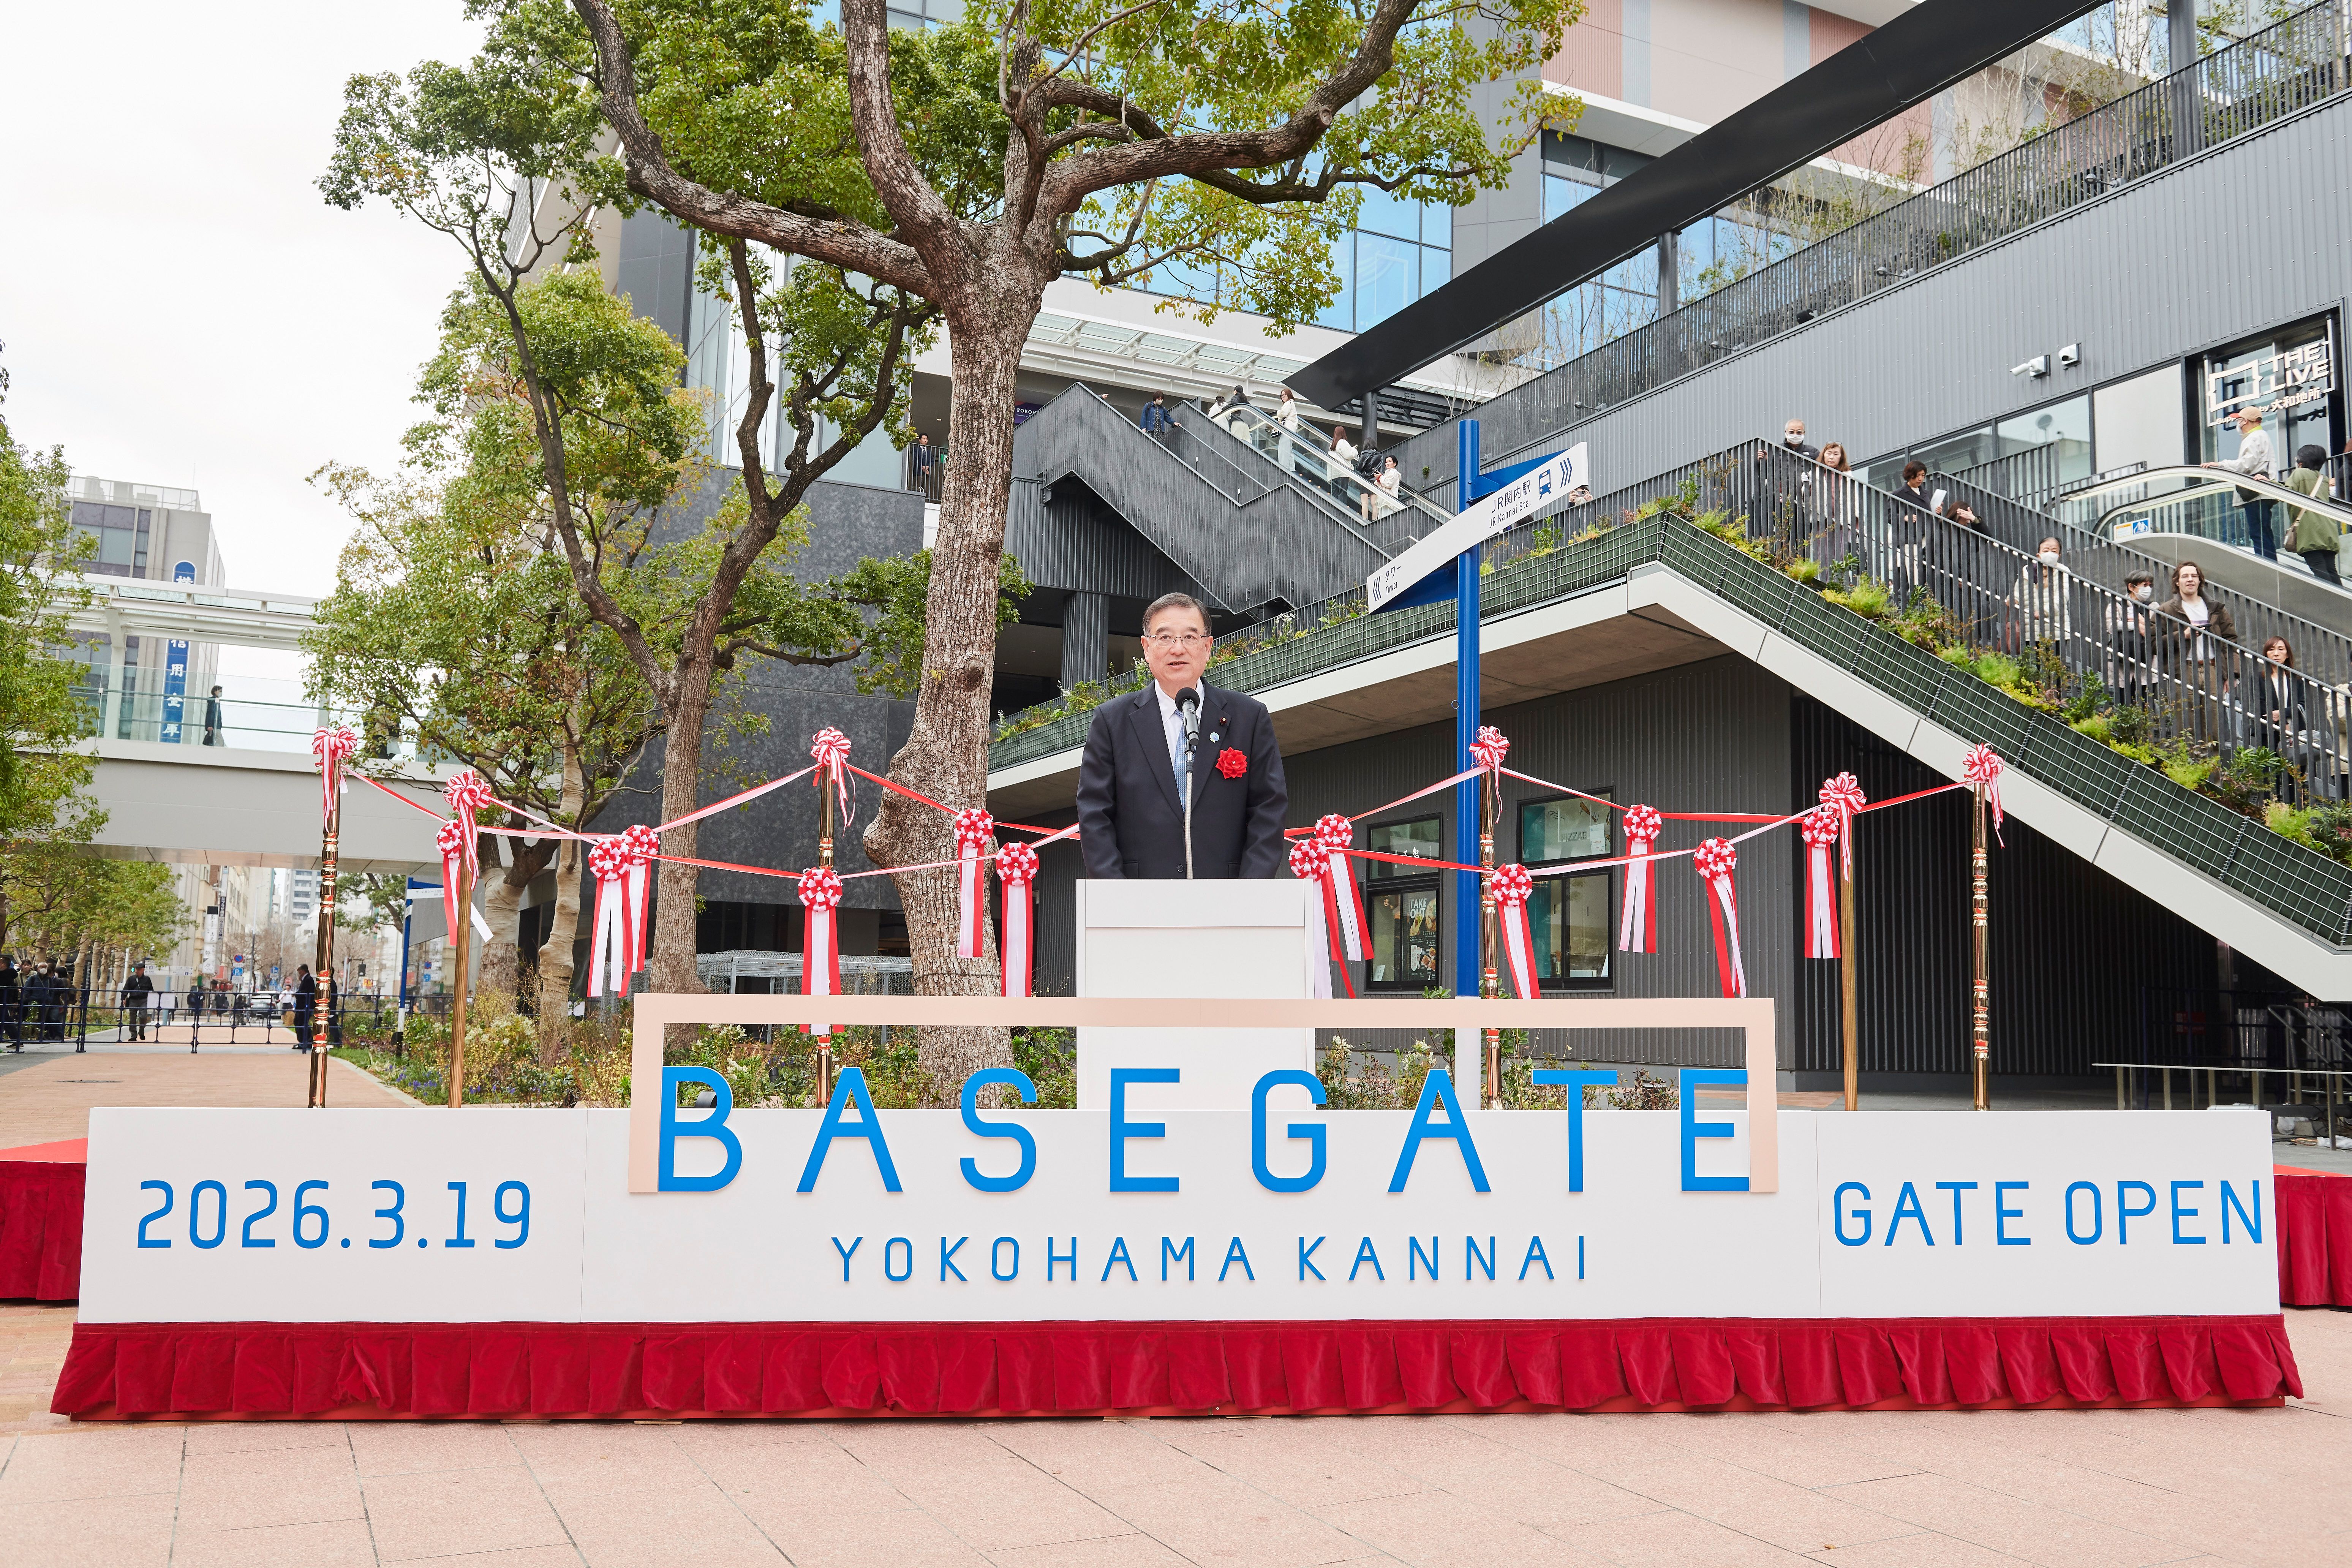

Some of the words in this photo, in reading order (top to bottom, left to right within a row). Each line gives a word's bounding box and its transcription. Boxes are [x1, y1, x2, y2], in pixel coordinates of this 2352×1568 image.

[2268, 342, 2322, 373] THE
[2270, 359, 2330, 392] LIVE
[2271, 388, 2322, 412] 大和地所
[1491, 479, 1530, 513] JR関内駅
[1489, 517, 1496, 528] JR
[1498, 504, 1517, 523] Kannai
[1519, 500, 1531, 511] Sta.
[1385, 566, 1401, 582] タワー
[1385, 581, 1398, 594] Tower
[1561, 831, 1582, 842] PIZZA
[1410, 898, 1427, 909] TAKE
[658, 1066, 1750, 1193] BASEGATE
[137, 1179, 531, 1249] 2026.3.19
[1834, 1181, 2031, 1246] GATE
[2064, 1180, 2262, 1245] OPEN
[832, 1236, 1255, 1282] YOKOHAMA
[1299, 1235, 1584, 1280] KANNAI
